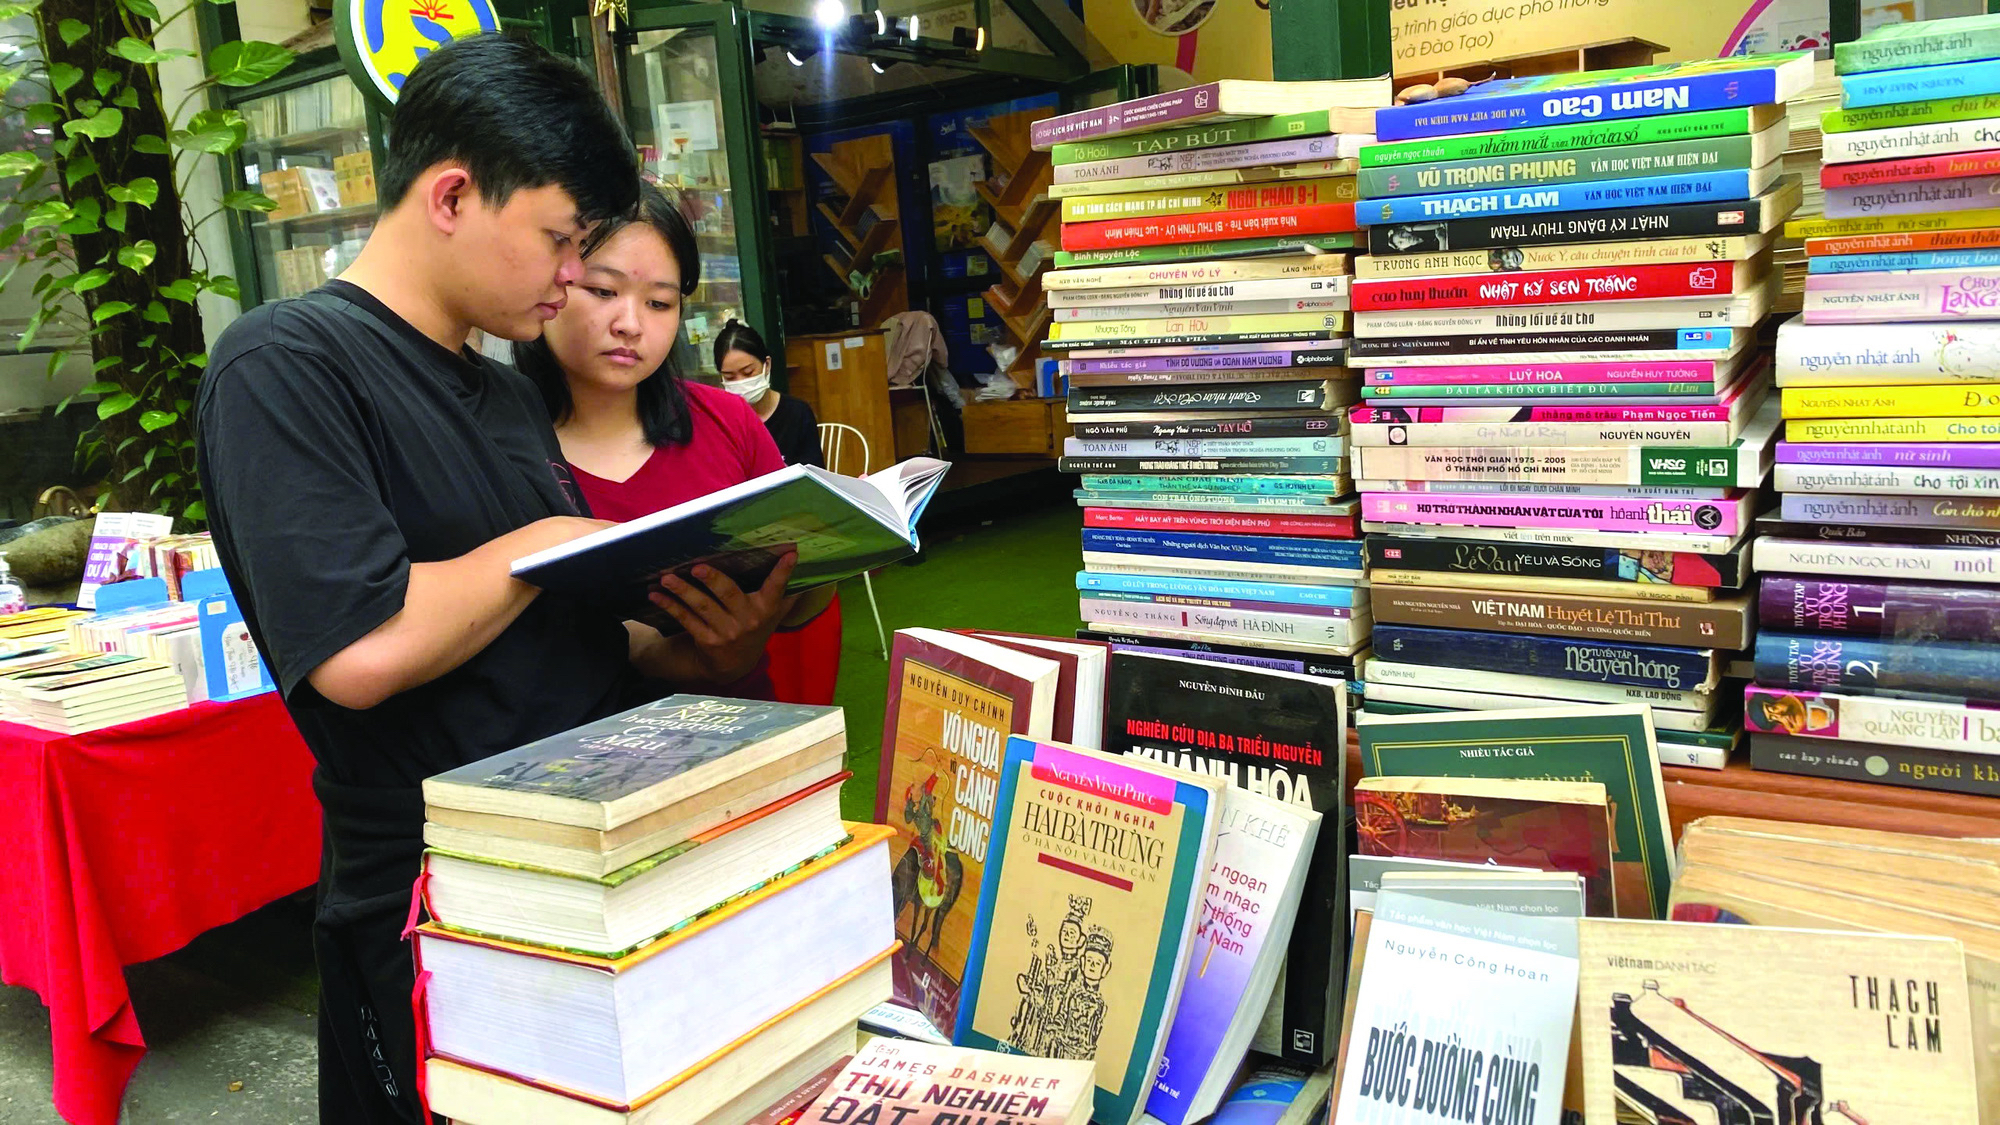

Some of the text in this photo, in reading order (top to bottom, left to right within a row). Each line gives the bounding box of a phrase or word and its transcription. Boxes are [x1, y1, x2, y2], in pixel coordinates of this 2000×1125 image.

[1404, 18, 1436, 36] trình
[1442, 12, 1477, 34] giáo
[1483, 8, 1514, 24] dục
[1397, 45, 1416, 59] và
[1420, 39, 1453, 56] Đào
[1543, 86, 1689, 117] Nam Cao
[1133, 128, 1236, 154] TẠP BÚT
[1075, 169, 1099, 178] TOAN
[1418, 167, 1440, 187] VŨ
[1444, 167, 1505, 187] TRỌNG
[1510, 159, 1576, 182] PHỤNG
[1654, 155, 1674, 167] NAM
[1610, 218, 1626, 233] KÝ
[1631, 215, 1669, 229] NHẬT
[1083, 444, 1106, 452] TOAN
[1545, 456, 1565, 464] 2005
[1542, 466, 1565, 474] MINH
[1649, 459, 1686, 470] VHSG
[1243, 618, 1259, 631] HÀ
[1472, 599, 1681, 629] VIỆT NAM Huyết Lệ Thi Thư
[1853, 603, 1885, 619] 1
[1845, 660, 1881, 679] 2
[909, 672, 1005, 722] NGUYỄN DUY CHÍNH
[1179, 678, 1218, 694] NGUYỄN
[1219, 682, 1243, 697] ĐÌNH
[1126, 718, 1322, 767] NGHIÊN CỨU ĐỊA BẠ TRIỀU NGUYỄN
[1494, 745, 1514, 757] TÁC
[954, 764, 997, 821] CÁNH
[1040, 788, 1071, 807] CUỘC
[1114, 808, 1156, 831] NGHĨA
[949, 809, 990, 863] CUNG
[1222, 866, 1268, 894] ngoạn
[1223, 890, 1260, 915] nhạc
[1210, 928, 1244, 956] Nam
[1385, 939, 1549, 982] Nguyễn Công Hoan
[1849, 975, 1939, 1019] THẠCH
[1886, 1014, 1942, 1053] LAM
[862, 1057, 1060, 1090] JAMES DASHNER
[1360, 1021, 1540, 1125] BƯỚC ĐƯỜNG CÙNG
